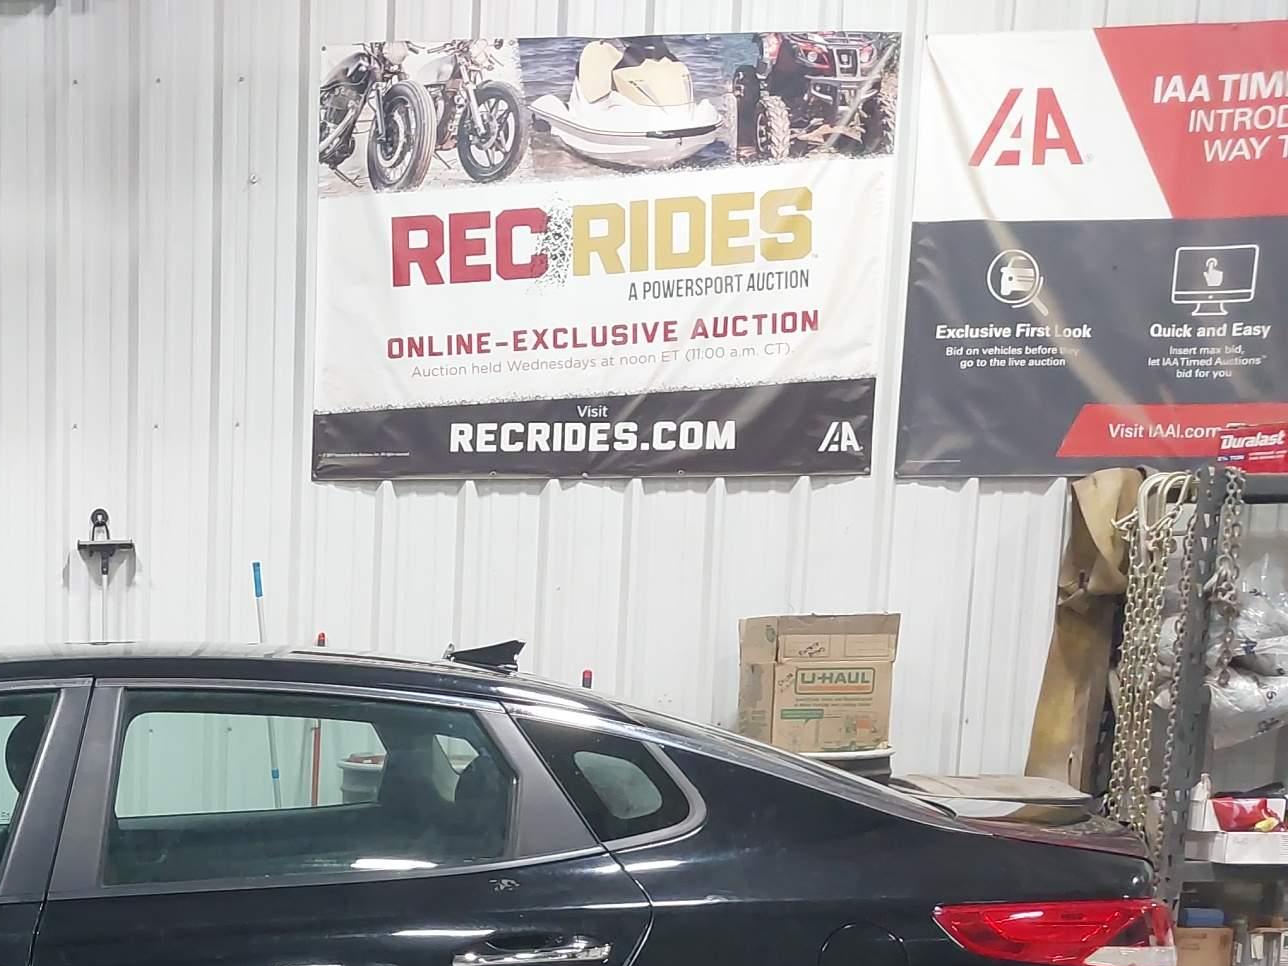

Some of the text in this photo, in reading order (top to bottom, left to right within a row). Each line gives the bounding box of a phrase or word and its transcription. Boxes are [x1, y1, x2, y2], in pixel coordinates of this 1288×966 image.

[1153, 71, 1288, 104] IAA TIM
[1203, 135, 1272, 162] WAY
[391, 186, 813, 288] REC RIDES
[628, 269, 810, 301] A POWERSPORT AUCTION
[387, 309, 819, 359] ONLINE-EXCLUSIVE AUCTION
[935, 323, 1092, 339] Exclusive First Look
[1149, 322, 1272, 339] Quick and Easy
[945, 346, 964, 356] Bid
[982, 346, 1022, 355] vehicles
[1024, 345, 1058, 355] before
[1169, 345, 1197, 355] Insert
[411, 364, 467, 378] Auction
[471, 361, 502, 375] held
[507, 357, 596, 374] Wednesdays
[601, 357, 614, 368] at
[619, 354, 656, 367] noon
[661, 350, 680, 363] ET
[685, 346, 725, 363] (11:00
[730, 346, 759, 358] a.m.
[959, 356, 1066, 369] go to the live auction
[1147, 356, 1160, 366] let
[1162, 357, 1179, 366] IAA
[1180, 356, 1213, 366] Timed
[1175, 368, 1232, 379] bid for you
[576, 405, 609, 418] Visit
[450, 420, 736, 452] RECRIDES.COM
[1108, 423, 1144, 438] Visit
[1220, 429, 1286, 450] Duralast
[800, 671, 871, 684] U-HAUL
